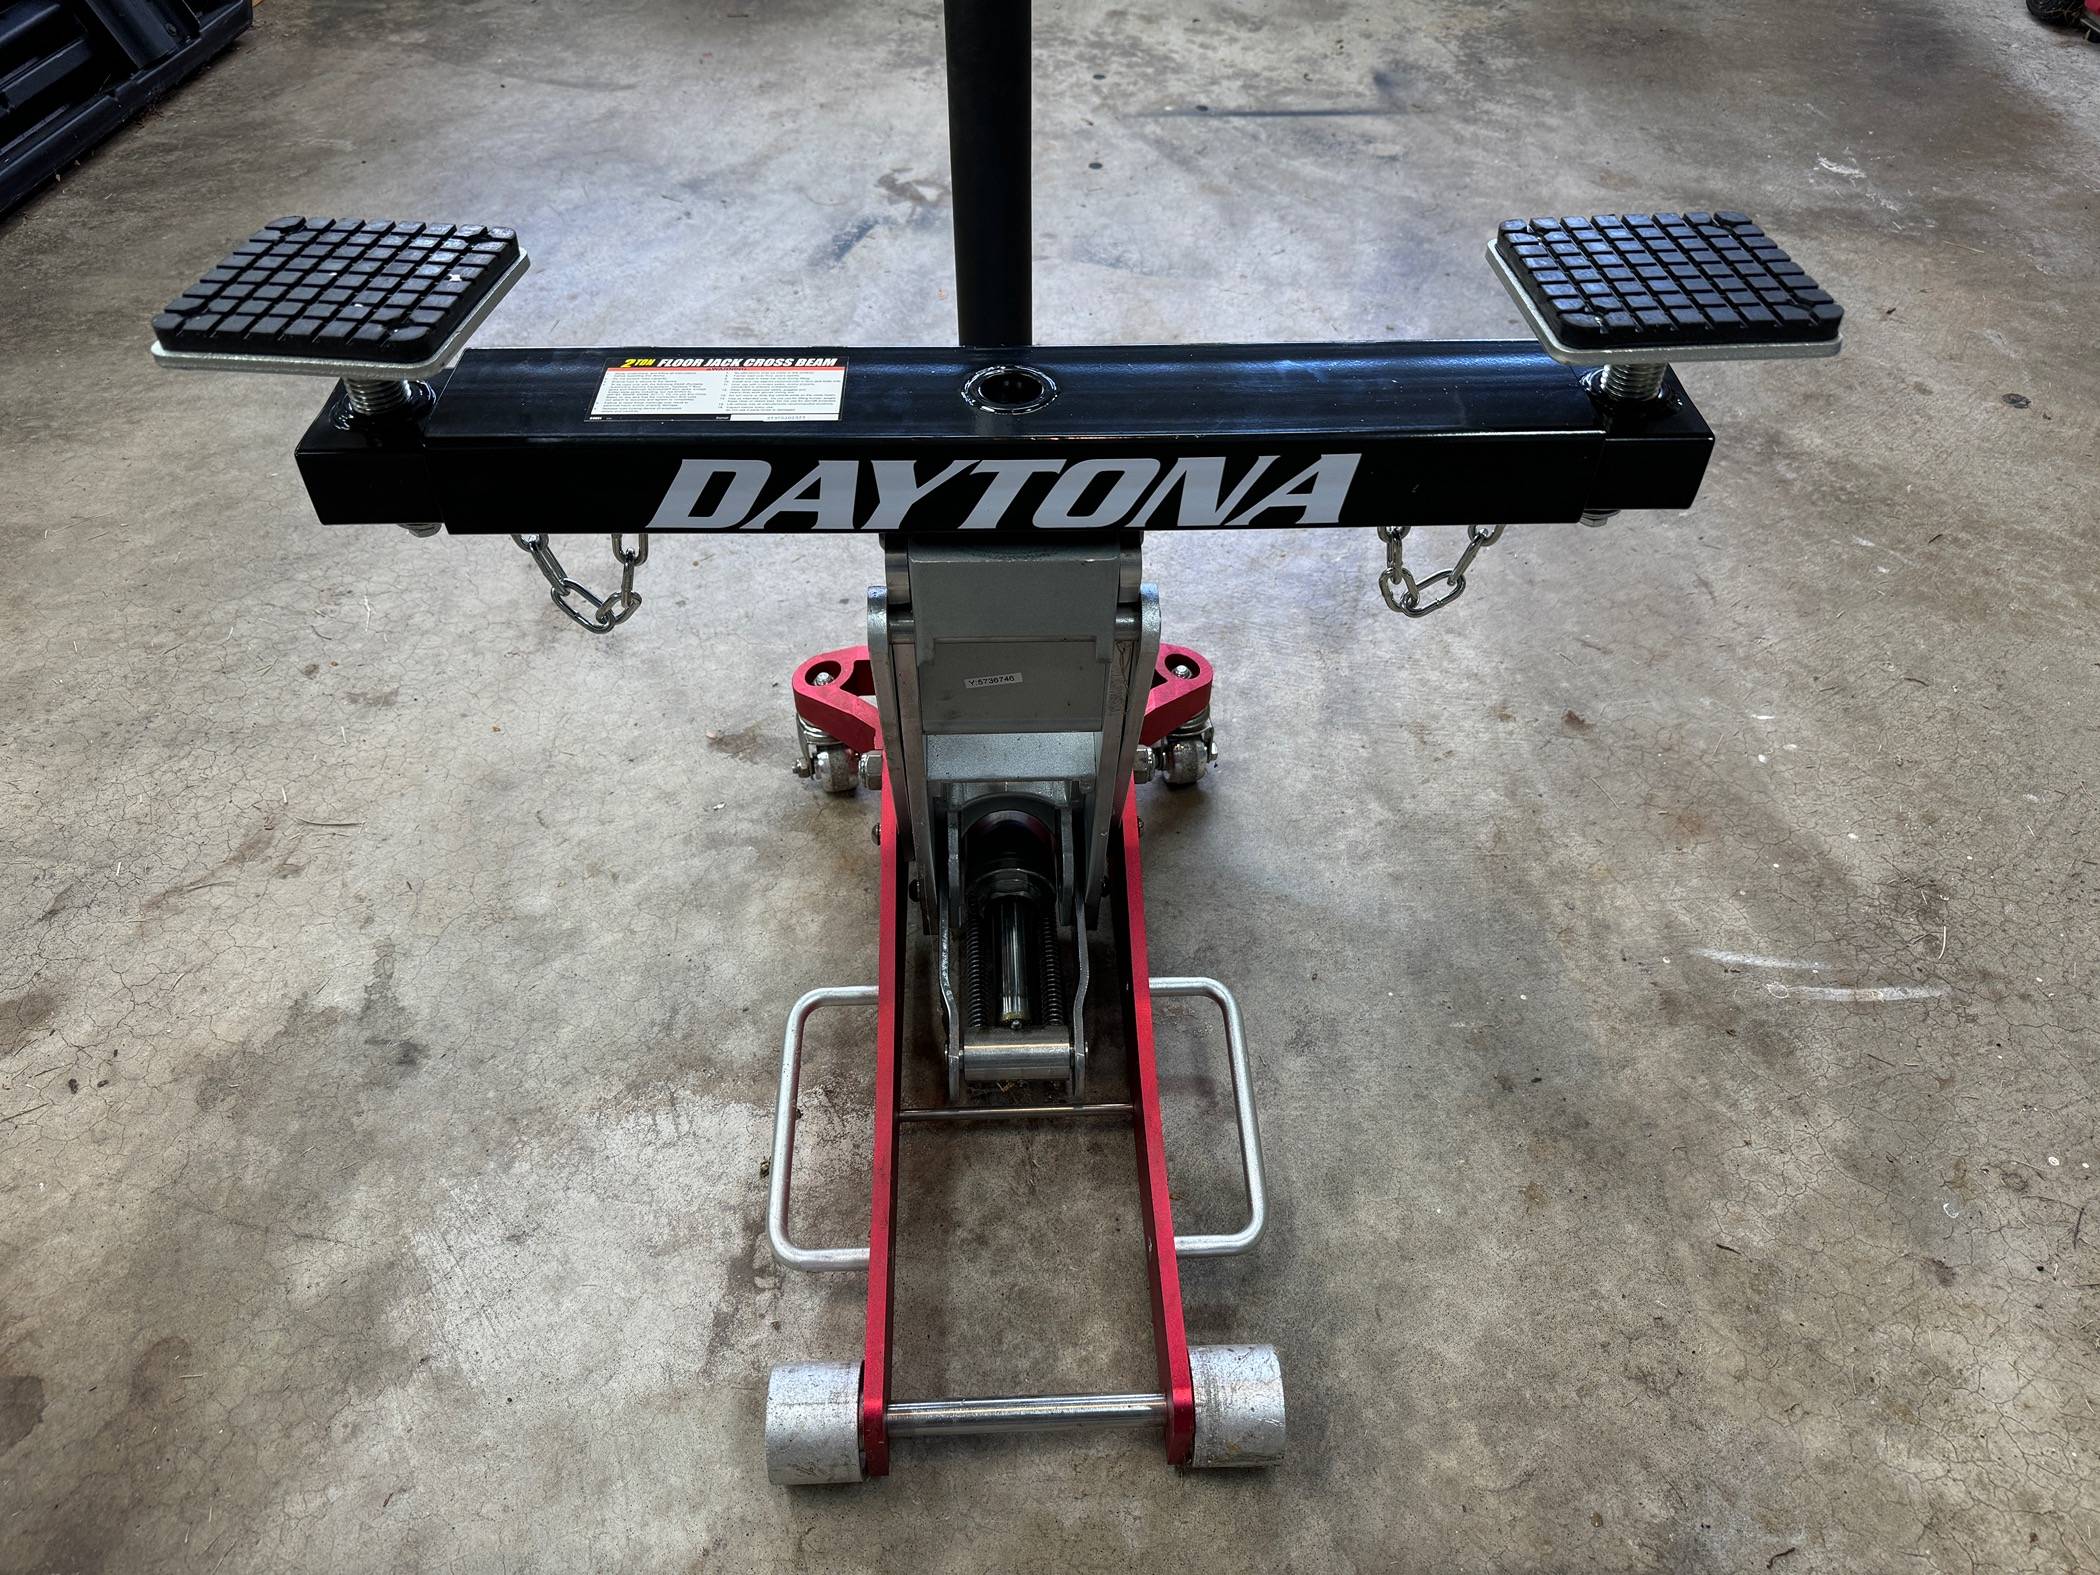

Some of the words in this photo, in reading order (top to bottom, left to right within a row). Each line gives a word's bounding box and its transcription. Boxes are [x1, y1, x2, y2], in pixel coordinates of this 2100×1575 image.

[620, 358, 637, 368] 2
[634, 358, 656, 366] TON
[656, 358, 705, 367] FLOOR
[703, 358, 744, 367] JACK
[743, 358, 795, 367] CROSS
[794, 358, 838, 367] BEAM
[645, 453, 1363, 529] DAYTONA
